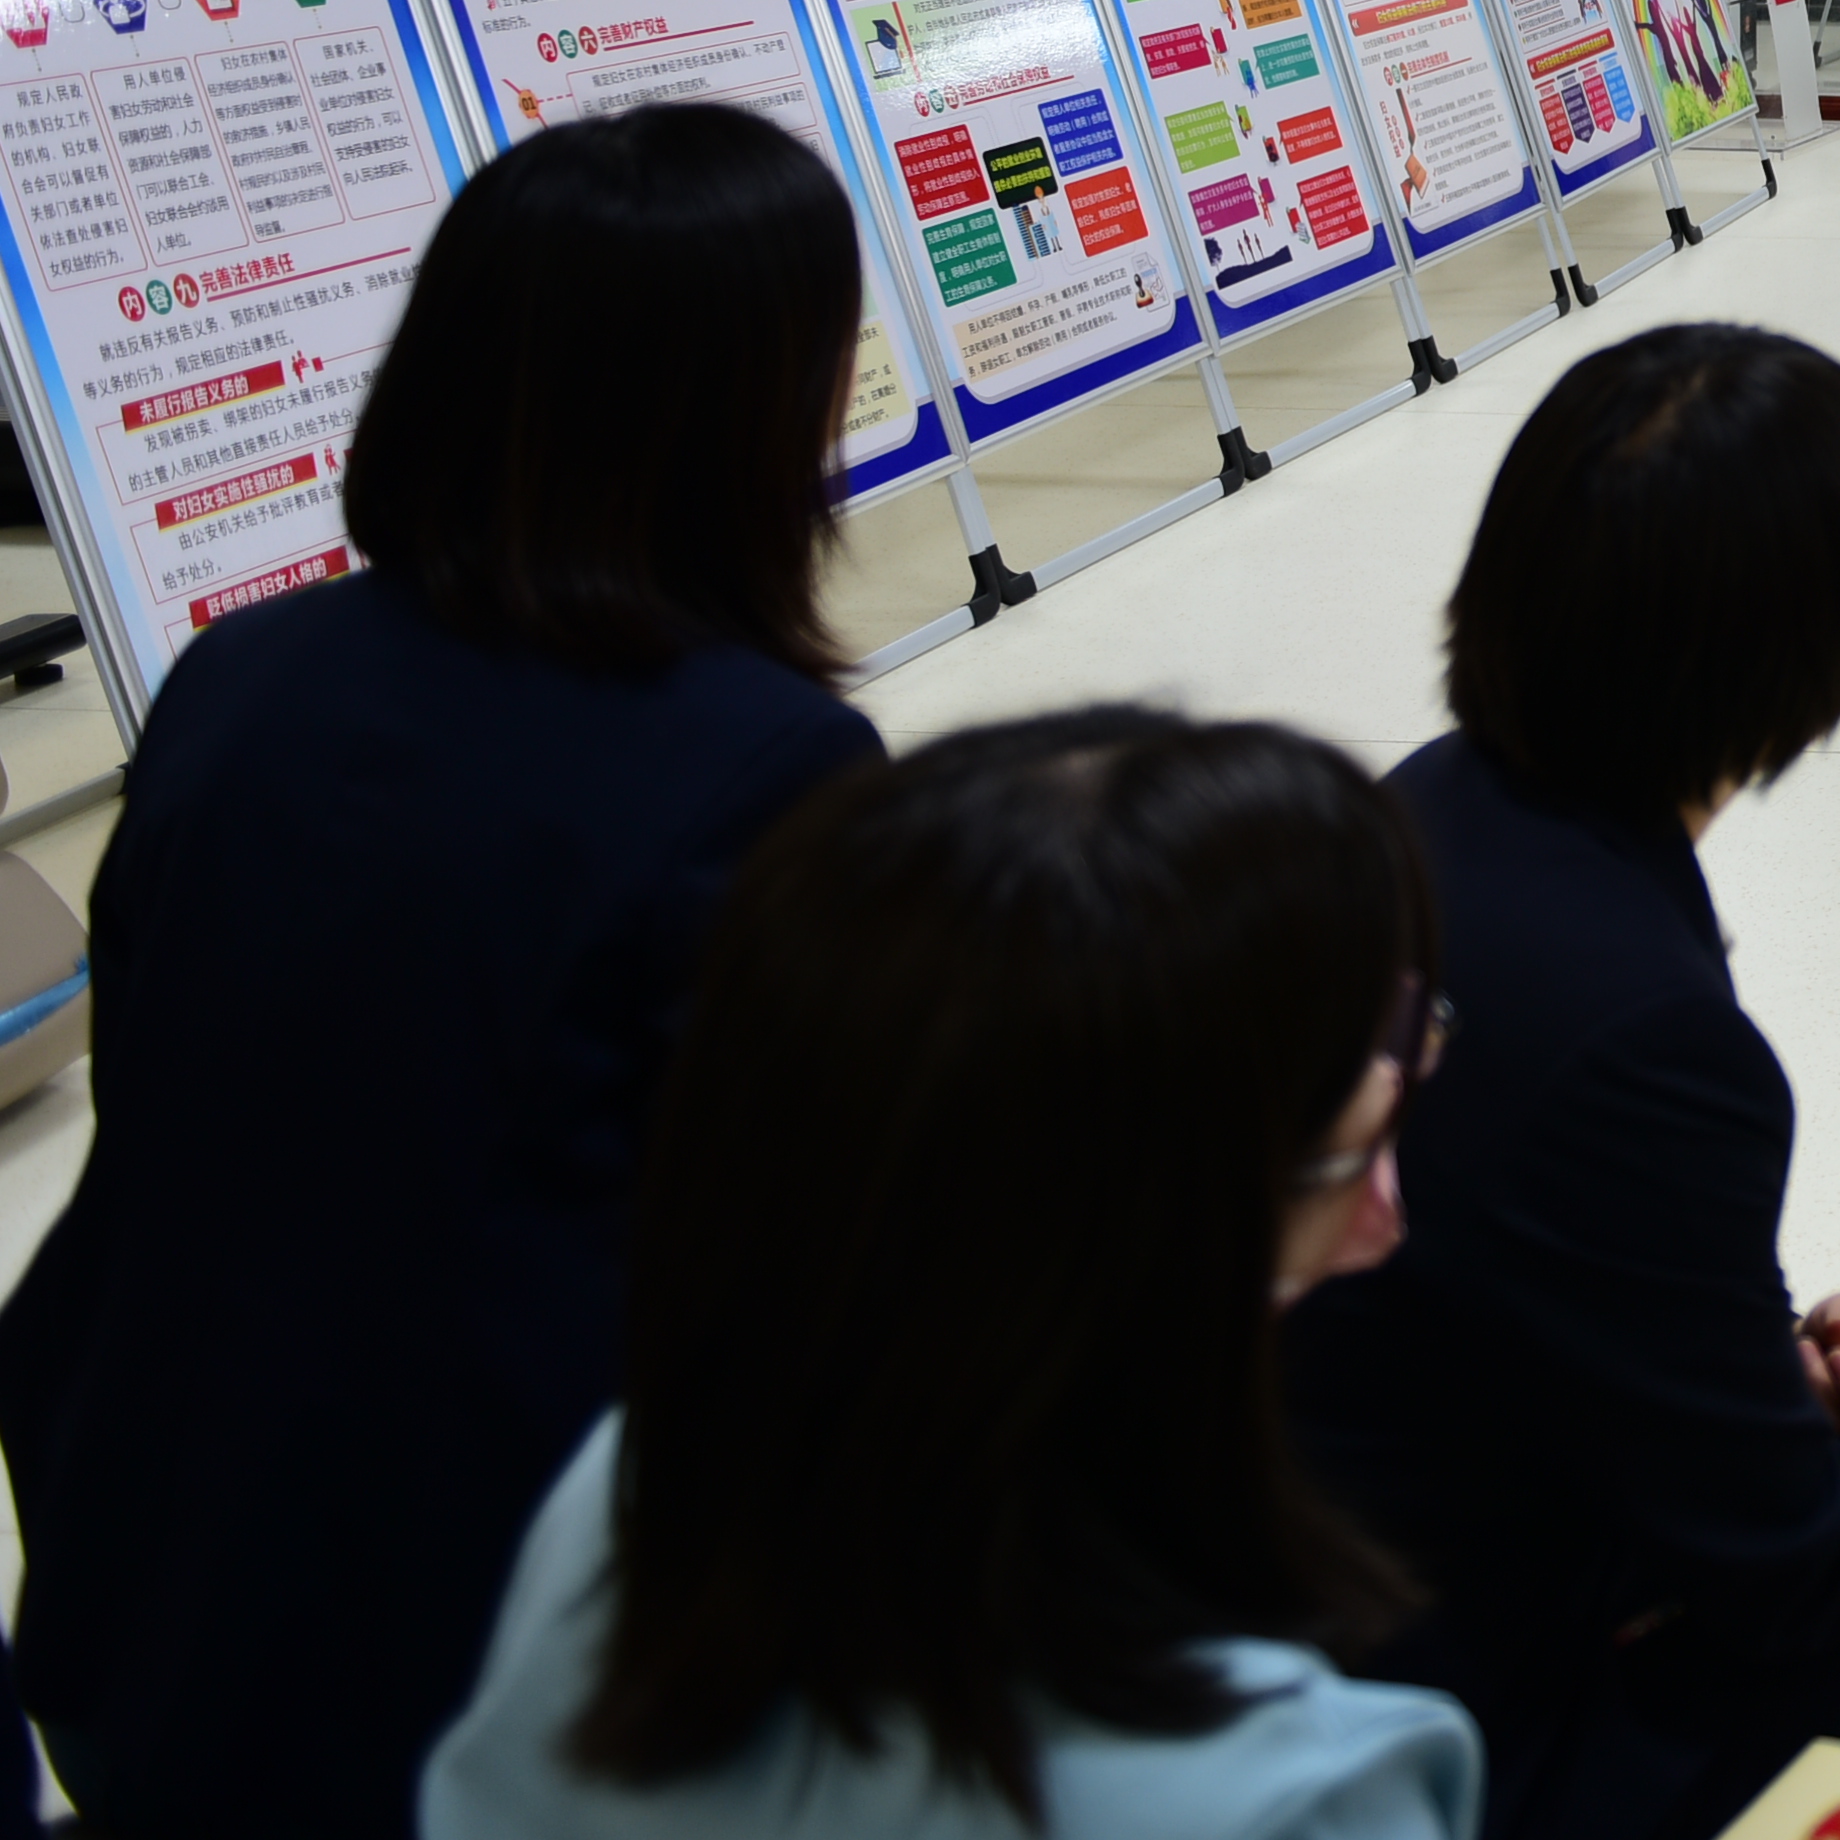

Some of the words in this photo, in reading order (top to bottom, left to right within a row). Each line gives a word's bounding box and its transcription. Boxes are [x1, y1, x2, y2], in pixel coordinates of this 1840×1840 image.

[540, 30, 597, 59] 内容六
[598, 17, 669, 44] 完善财产权益
[220, 48, 288, 70] 妇女在农村集体
[123, 67, 187, 91] 用人单位侵
[17, 85, 83, 107] 规定人民政
[109, 93, 195, 120] 害妇女劳动和社会
[522, 95, 537, 112] 01
[2, 111, 92, 139] 府负责妇女工作
[11, 137, 102, 167] 的机构、妇女联
[127, 145, 213, 175] 资源和社会保障部
[21, 165, 110, 196] 合会可以督促有
[30, 191, 120, 223] 关部门或者单位
[39, 218, 128, 251] 依法查处侵害妇
[122, 277, 197, 319] 内容九
[199, 253, 295, 295] 完善法律责任
[140, 376, 249, 424] 未履行报告义务的
[173, 465, 294, 521] 对妇女实施性骚扰的
[162, 560, 223, 591] 给予处分。
